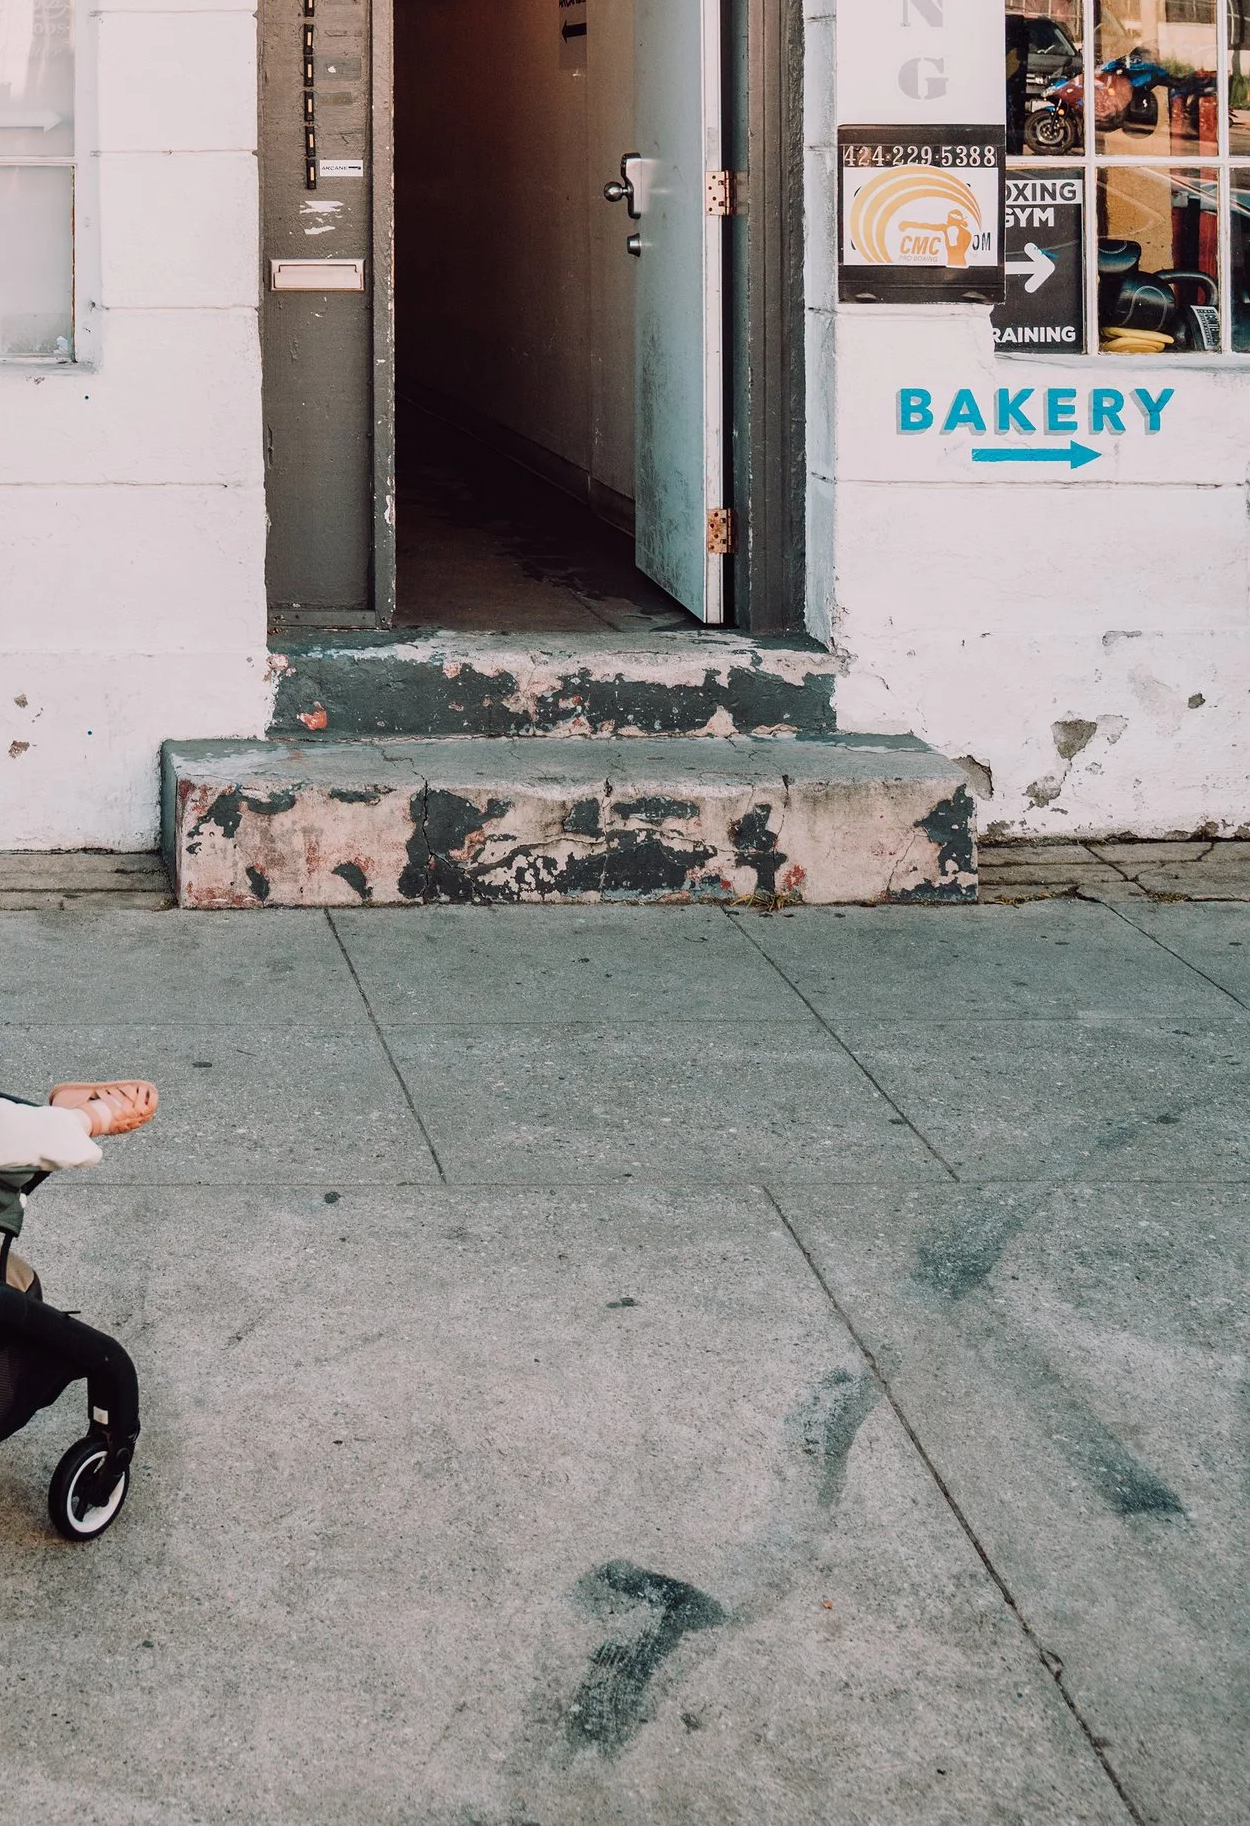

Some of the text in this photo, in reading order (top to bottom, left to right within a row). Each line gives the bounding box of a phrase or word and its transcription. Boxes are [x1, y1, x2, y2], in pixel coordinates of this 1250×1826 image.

[900, 235, 942, 255] CMC
[913, 255, 939, 263] BOXING
[897, 387, 1175, 435] BAKERY
